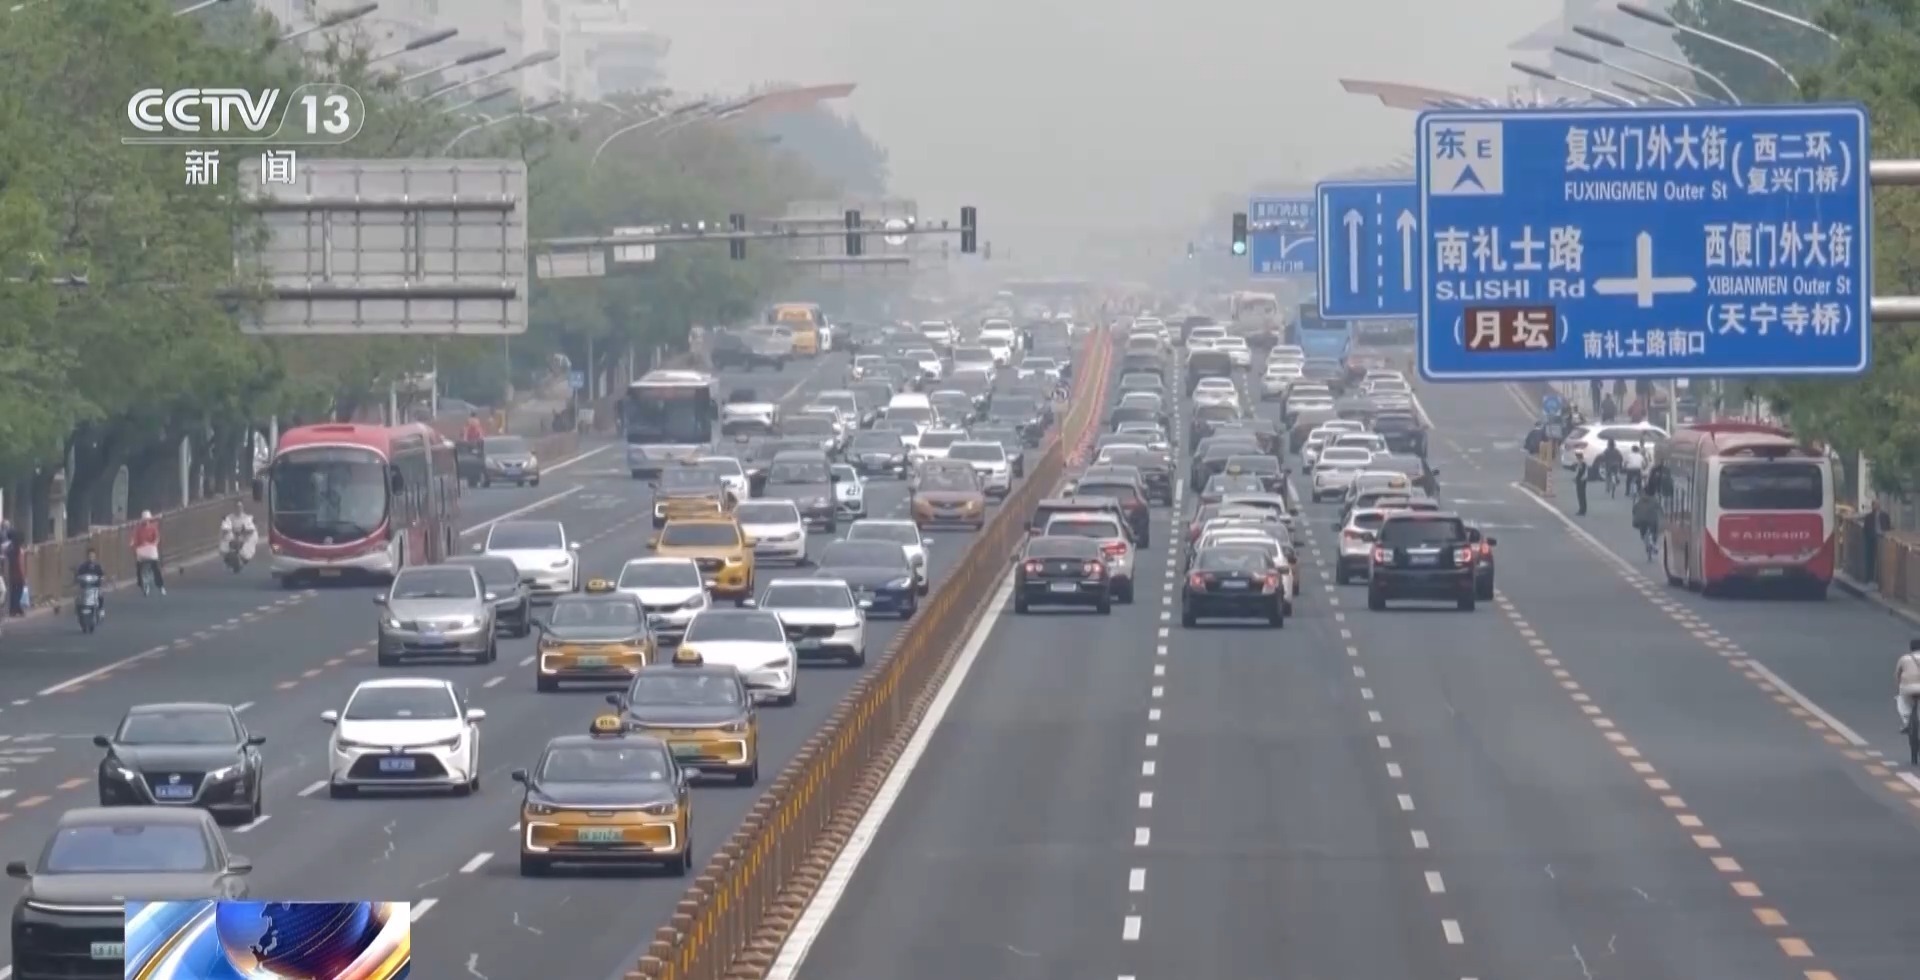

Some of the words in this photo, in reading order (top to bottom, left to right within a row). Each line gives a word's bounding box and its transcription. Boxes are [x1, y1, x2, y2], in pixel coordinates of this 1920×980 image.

[1434, 127, 1467, 160] 东
[1476, 138, 1493, 159] E
[1565, 124, 1728, 173] 复兴门外大街
[1751, 131, 1833, 162] 西二环
[1564, 180, 1658, 201] FUXINGMEN
[1663, 181, 1706, 201] Outer
[1711, 180, 1729, 201] St
[1747, 165, 1839, 195] 复兴门桥
[1434, 225, 1584, 273] 南礼士路
[1703, 220, 1853, 269] 西便门外大街
[1435, 279, 1530, 301] S.LISHI
[1549, 279, 1586, 299] Rd
[1707, 275, 1788, 296] XIBIANMEN
[1793, 275, 1832, 296] Outer
[1836, 274, 1852, 295] St
[1582, 329, 1705, 360] 南礼士路南口
